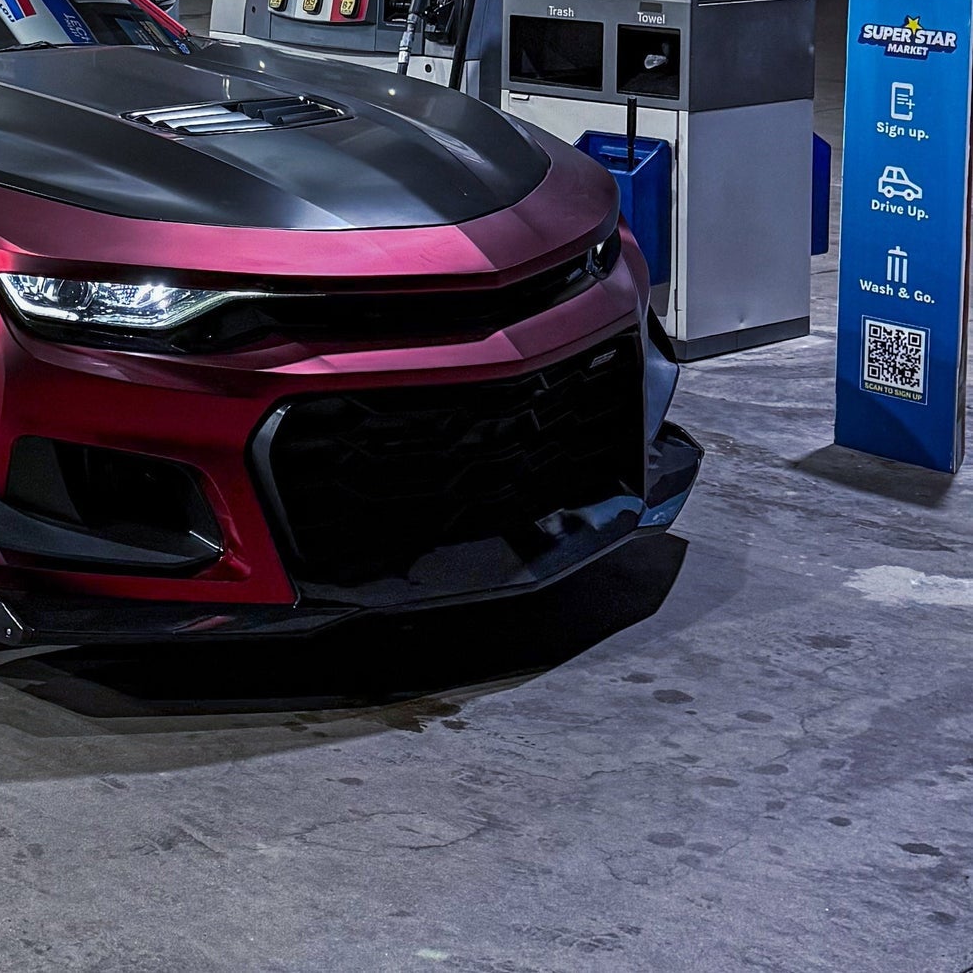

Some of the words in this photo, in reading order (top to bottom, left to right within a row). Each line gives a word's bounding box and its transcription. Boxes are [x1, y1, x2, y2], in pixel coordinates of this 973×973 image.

[548, 5, 575, 18] Trash
[637, 11, 666, 24] Towel
[863, 24, 911, 43] SUPER
[915, 30, 957, 48] STAR
[887, 43, 929, 56] MARKET
[877, 121, 905, 138] Sign
[909, 129, 929, 141] up.
[871, 199, 904, 215] Drive
[907, 205, 929, 221] Up.
[859, 279, 894, 296] Wash
[898, 287, 910, 299] &
[913, 290, 935, 304] Go.
[864, 382, 883, 392] SCAN
[894, 389, 912, 398] SIGN
